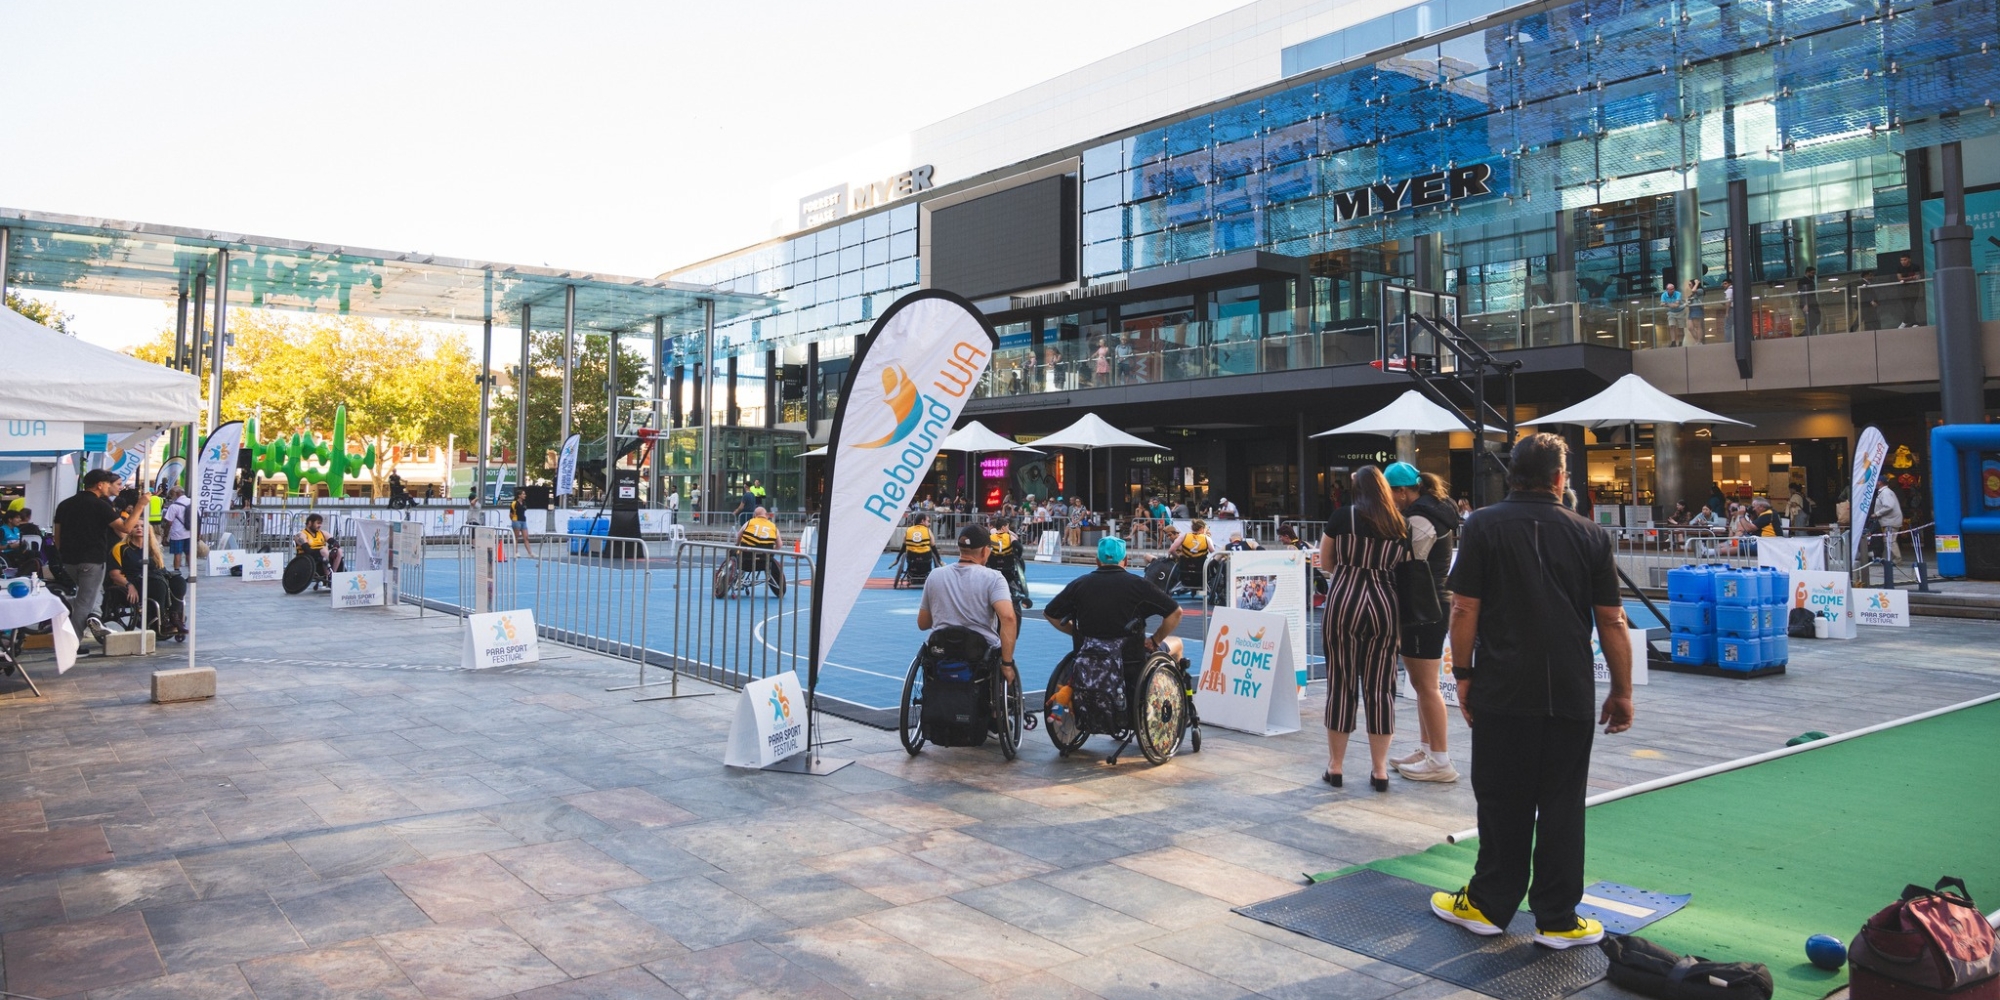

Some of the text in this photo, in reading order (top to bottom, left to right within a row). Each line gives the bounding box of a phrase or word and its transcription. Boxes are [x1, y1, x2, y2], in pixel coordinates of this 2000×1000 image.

[853, 164, 934, 211] MYER
[1333, 163, 1491, 222] MYER
[803, 192, 841, 214] FORREST
[807, 209, 836, 227] CHASE
[9, 420, 47, 436] WA
[864, 341, 986, 522] Rebound WA
[200, 467, 214, 497] SPORT
[1860, 463, 1878, 514] Rebound
[753, 524, 771, 539] 15
[912, 531, 922, 542] 8
[1190, 541, 1200, 553] 2
[1811, 594, 1844, 606] COME
[485, 643, 528, 657] PARA SPORT
[1235, 637, 1275, 651] Rebound WA
[492, 653, 523, 664] FESTIVAL
[1231, 648, 1273, 671] COME
[1593, 662, 1604, 671] RA
[1244, 668, 1253, 680] &
[1233, 678, 1262, 699] TRY
[1439, 681, 1458, 692] SPOR
[768, 724, 801, 747] PARA SPORT
[774, 738, 798, 757] FESTIVAL
